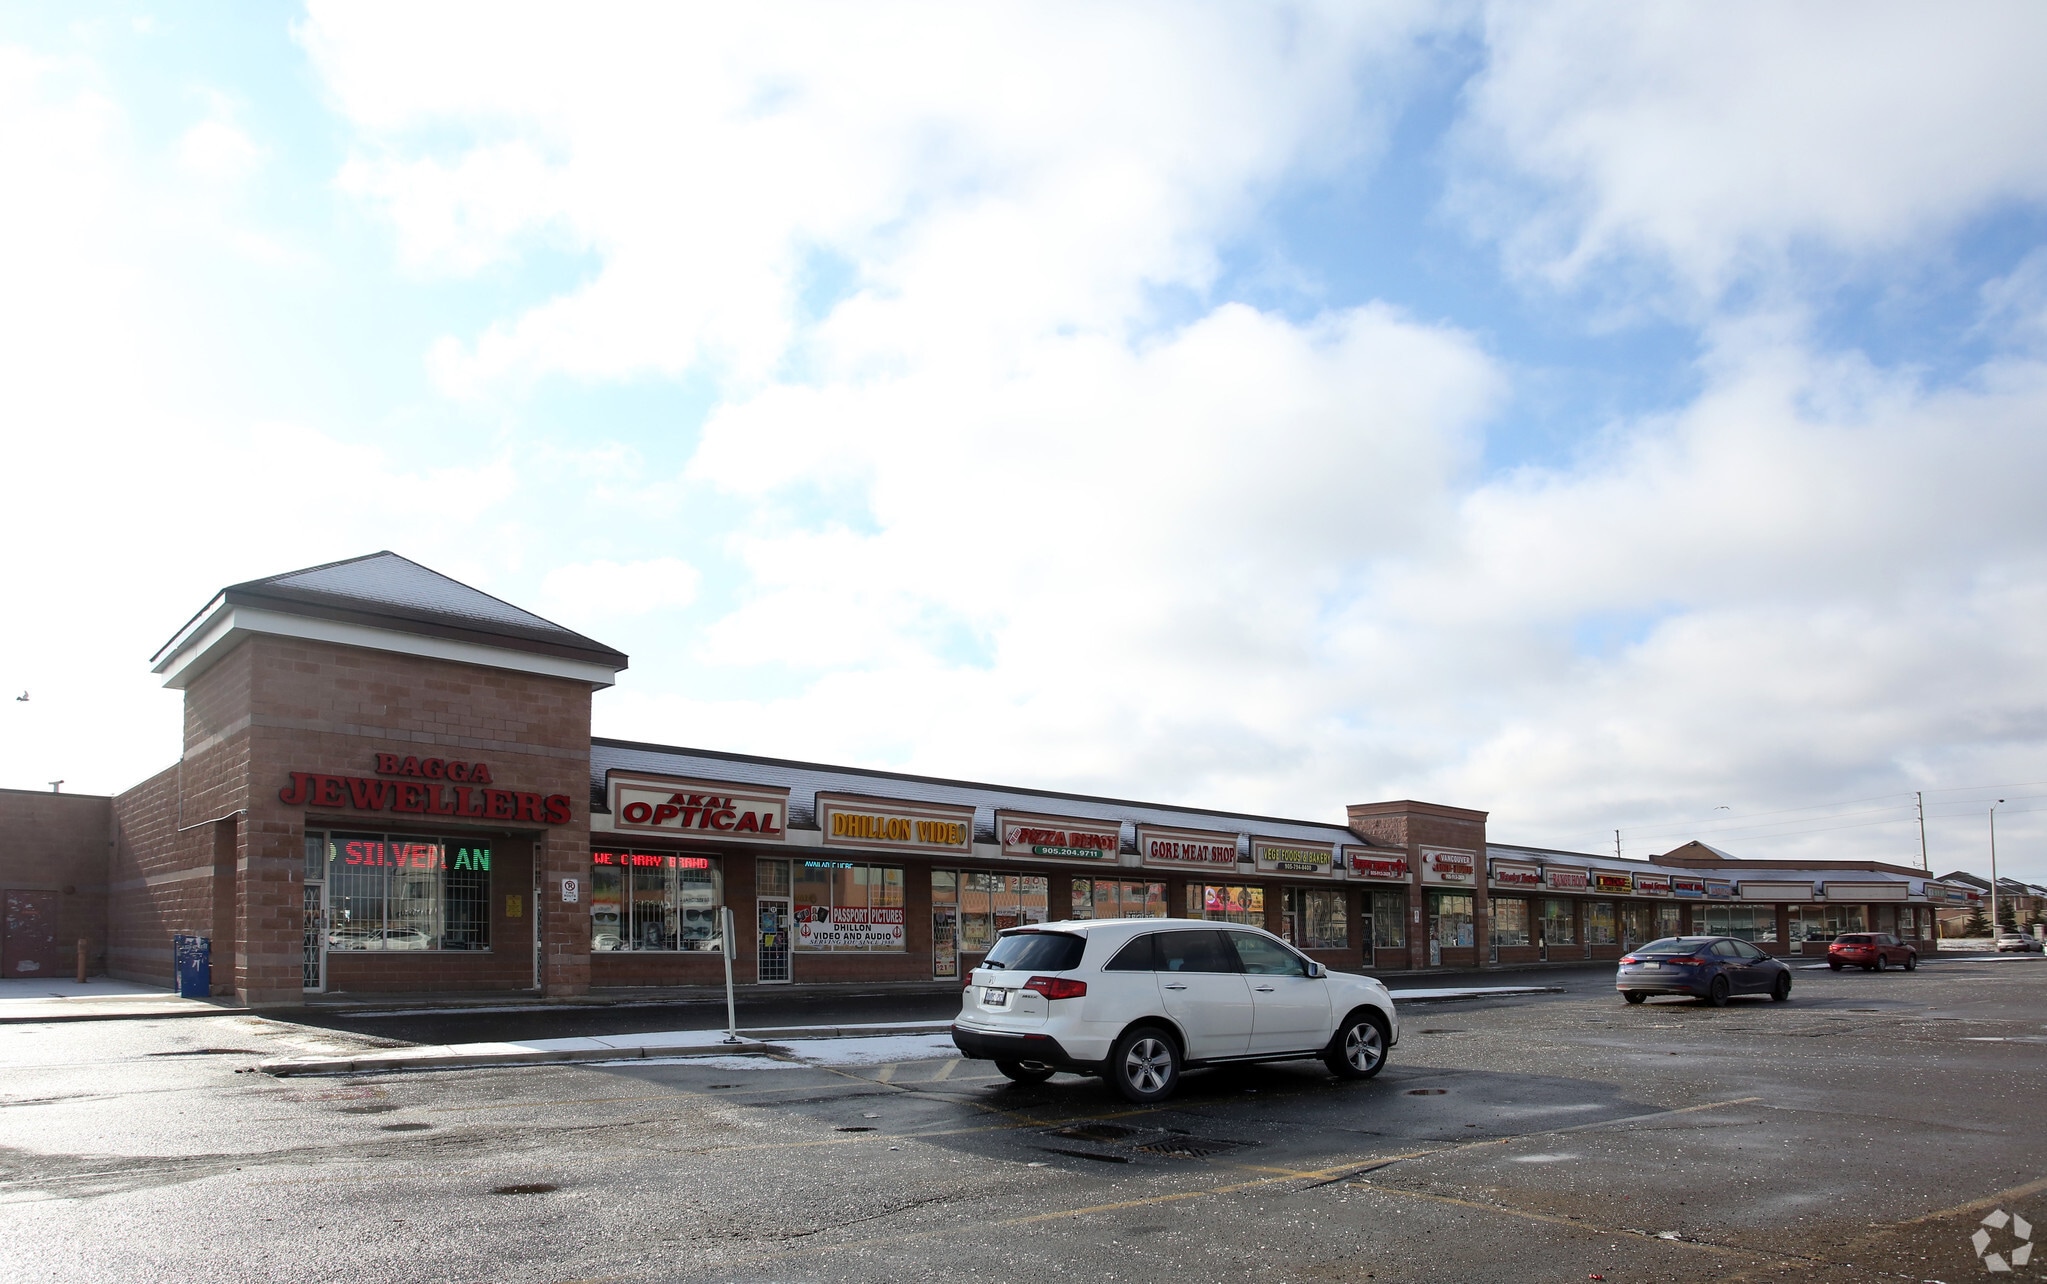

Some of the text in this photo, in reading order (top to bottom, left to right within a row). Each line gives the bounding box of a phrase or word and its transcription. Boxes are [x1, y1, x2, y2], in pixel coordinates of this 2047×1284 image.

[376, 753, 493, 783] BAGGA
[280, 772, 572, 824] JEWELLERS
[667, 793, 737, 810] AKAL
[623, 802, 780, 833] OPTICAL
[833, 813, 966, 845] DHILLON VIDEO
[1019, 828, 1067, 846] PIZZA
[1069, 833, 1118, 850] DEPOT
[345, 842, 448, 869] SILVER
[594, 853, 612, 865] WE
[621, 854, 662, 867] CARRY
[1042, 847, 1098, 857] 905.204.9711
[1151, 841, 1235, 862] GORE MEAT SHOP
[1263, 848, 1279, 861] VEGE
[1281, 849, 1301, 862] FOODS
[1309, 851, 1331, 864] BAKERY
[1441, 854, 1470, 864] VANCOUVER
[833, 908, 903, 923] PASSPORT PICTURES
[813, 932, 840, 940] VIDEO
[843, 932, 864, 940] AND
[834, 924, 872, 932] DHILLON
